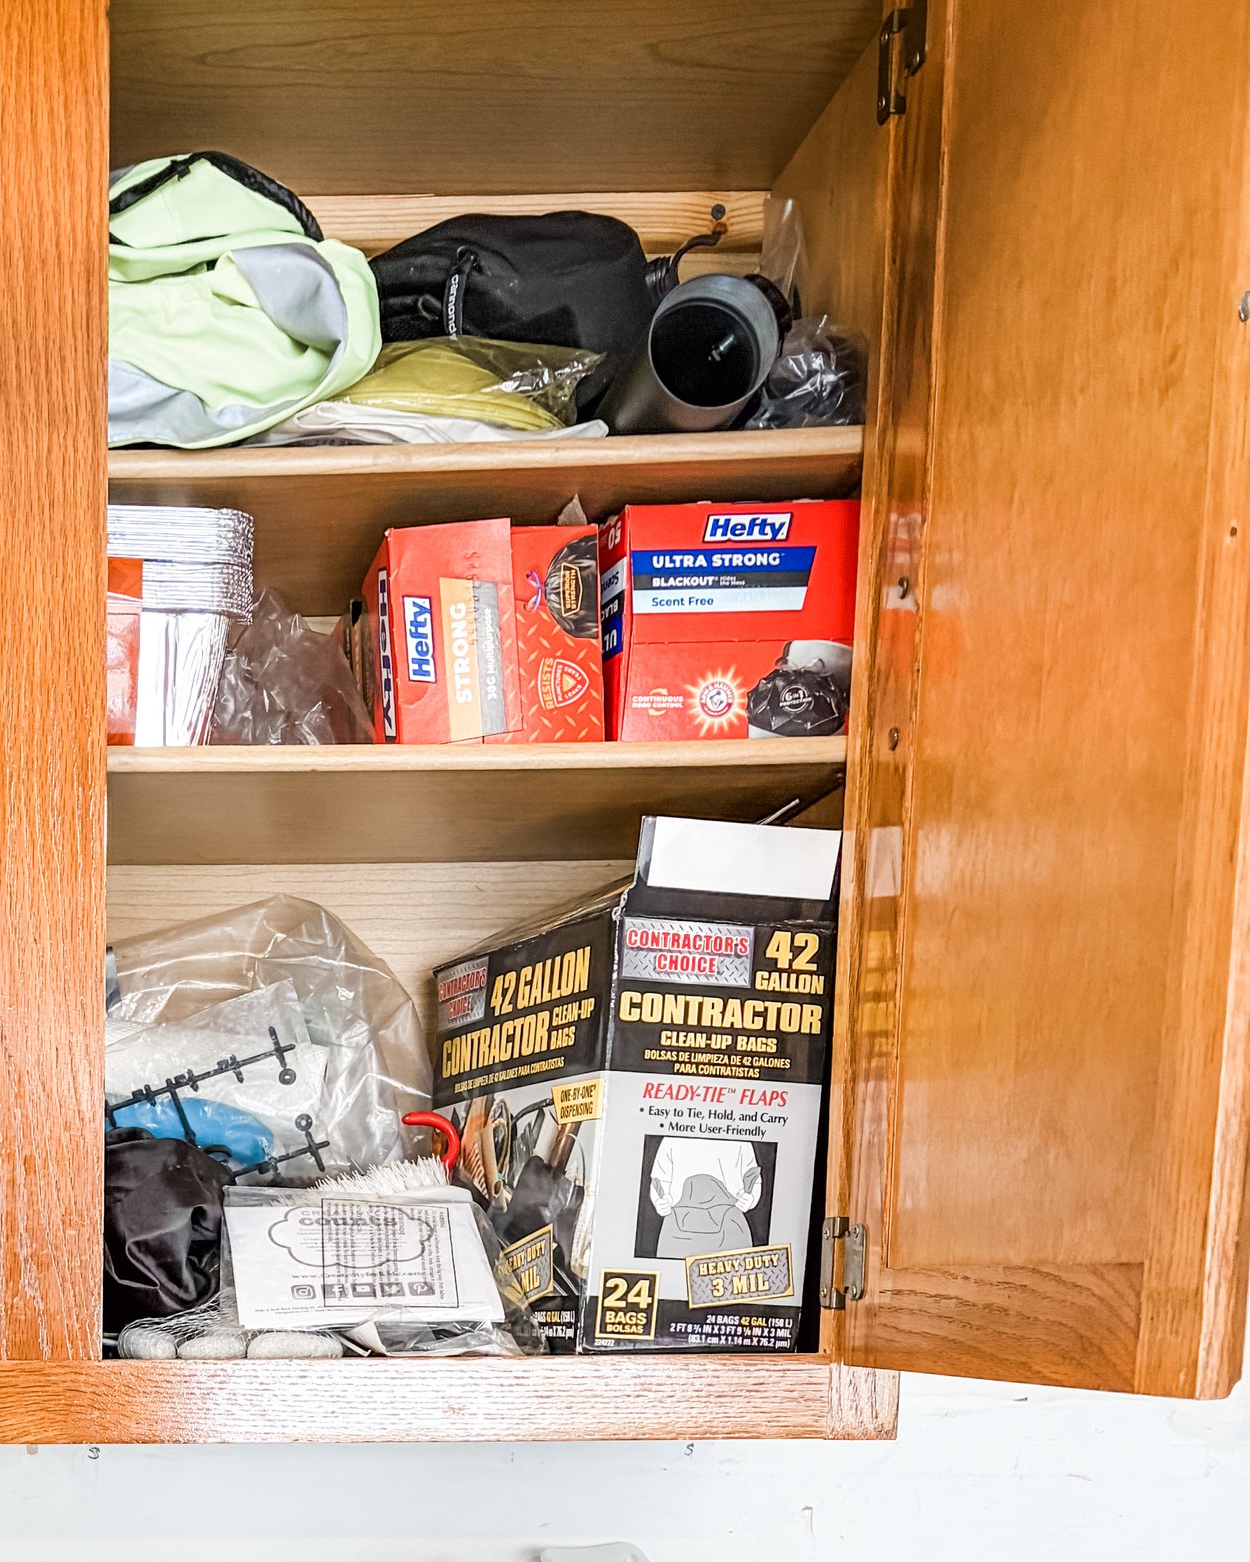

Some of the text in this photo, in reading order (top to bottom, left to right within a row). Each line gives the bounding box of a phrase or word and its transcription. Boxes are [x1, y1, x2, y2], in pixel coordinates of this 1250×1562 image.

[709, 517, 785, 540] Hefty
[652, 555, 707, 568] ULTRA
[651, 597, 714, 607] Scent Free
[409, 601, 432, 677] Hefty
[484, 608, 498, 673] Multipurpose
[450, 602, 473, 704] STRONG
[540, 657, 555, 709] RESISTS
[632, 695, 684, 703] CONTINUOUS
[627, 929, 749, 954] CONTRACTOR'S
[766, 931, 820, 971] 42
[656, 954, 717, 974] CHOICE
[490, 946, 591, 1017] 42 GALLON
[755, 971, 825, 994] GALLON
[552, 998, 595, 1026] CLEAN-UP
[619, 991, 823, 1035] CONTRACTOR
[442, 1010, 550, 1079] CONTRACTOR
[550, 1026, 576, 1050] BAGS
[660, 1031, 778, 1053] CLEAN-UP BAGS
[645, 1050, 791, 1069] BOLSAS DE LIMPIEZA DE 42 GALONES
[674, 1063, 760, 1078] PARA CONTRATISTAS
[739, 1089, 788, 1107] FLAPS
[560, 1101, 593, 1119] DISPENSING
[648, 1106, 788, 1126] Easy to Tie, Hold, and Carry
[668, 1122, 767, 1140] More User-Friendly
[699, 1253, 779, 1276] HEAVY DUTY
[520, 1269, 540, 1293] MIL
[711, 1273, 770, 1298] 3 MIL
[603, 1277, 652, 1309] 24
[604, 1311, 647, 1325] BAGS
[606, 1324, 644, 1334] BOLSAS
[706, 1315, 792, 1328] 24 BAGS 42 GAL (158 L)
[688, 1334, 705, 1344] (83.1
[707, 1336, 719, 1344] cm
[720, 1336, 727, 1344] X
[728, 1337, 742, 1345] 1.14
[743, 1338, 751, 1346] m
[752, 1338, 759, 1346] X
[759, 1338, 774, 1346] 76.2
